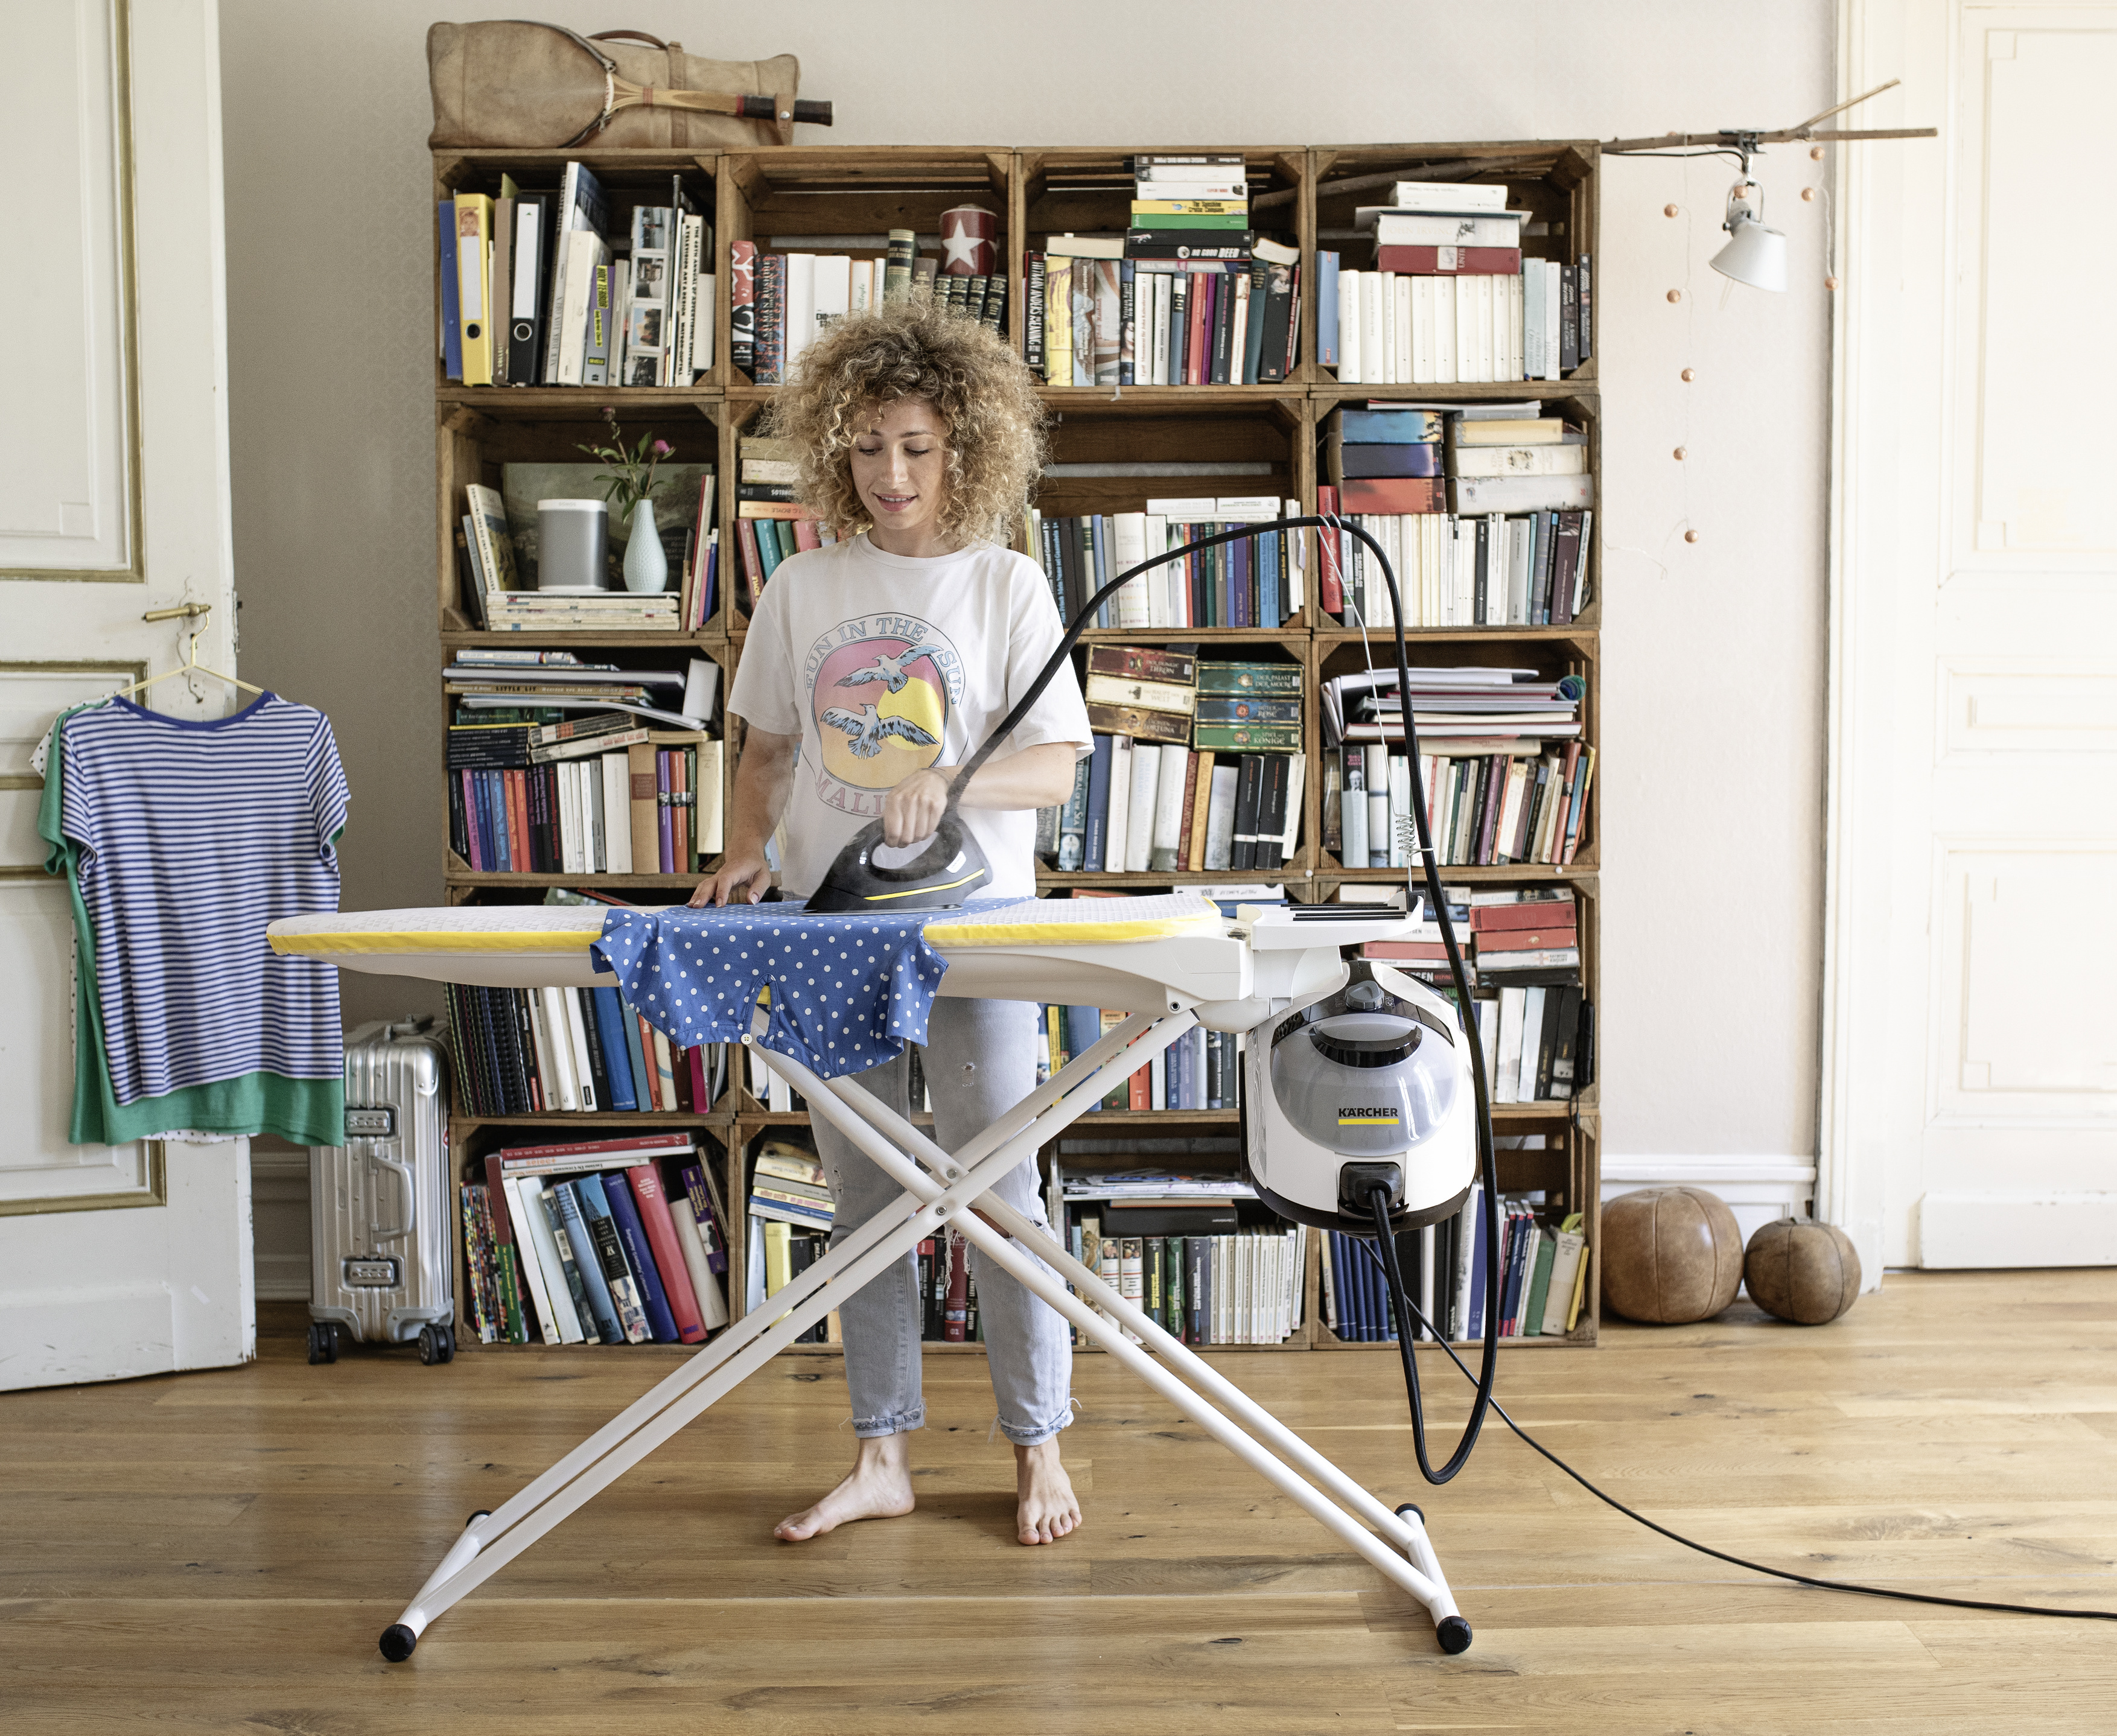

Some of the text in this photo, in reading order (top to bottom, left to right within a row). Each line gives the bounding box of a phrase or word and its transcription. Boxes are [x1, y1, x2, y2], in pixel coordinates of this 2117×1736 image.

[1218, 247, 1241, 258] DEED
[1031, 262, 1045, 289] HITMAN
[1030, 289, 1043, 314] ANDERS
[751, 576, 761, 596] BOYLE
[806, 635, 836, 690] FUN
[837, 616, 963, 705] IN THE SUN
[1150, 665, 1174, 675] THRON
[1253, 735, 1285, 744] KÖNIGE
[816, 768, 885, 816] MALI
[1072, 810, 1084, 825] SEA
[1475, 895, 1490, 905] John
[1338, 1107, 1398, 1118] KÄRCHER
[966, 1279, 976, 1297] LEXIKON
